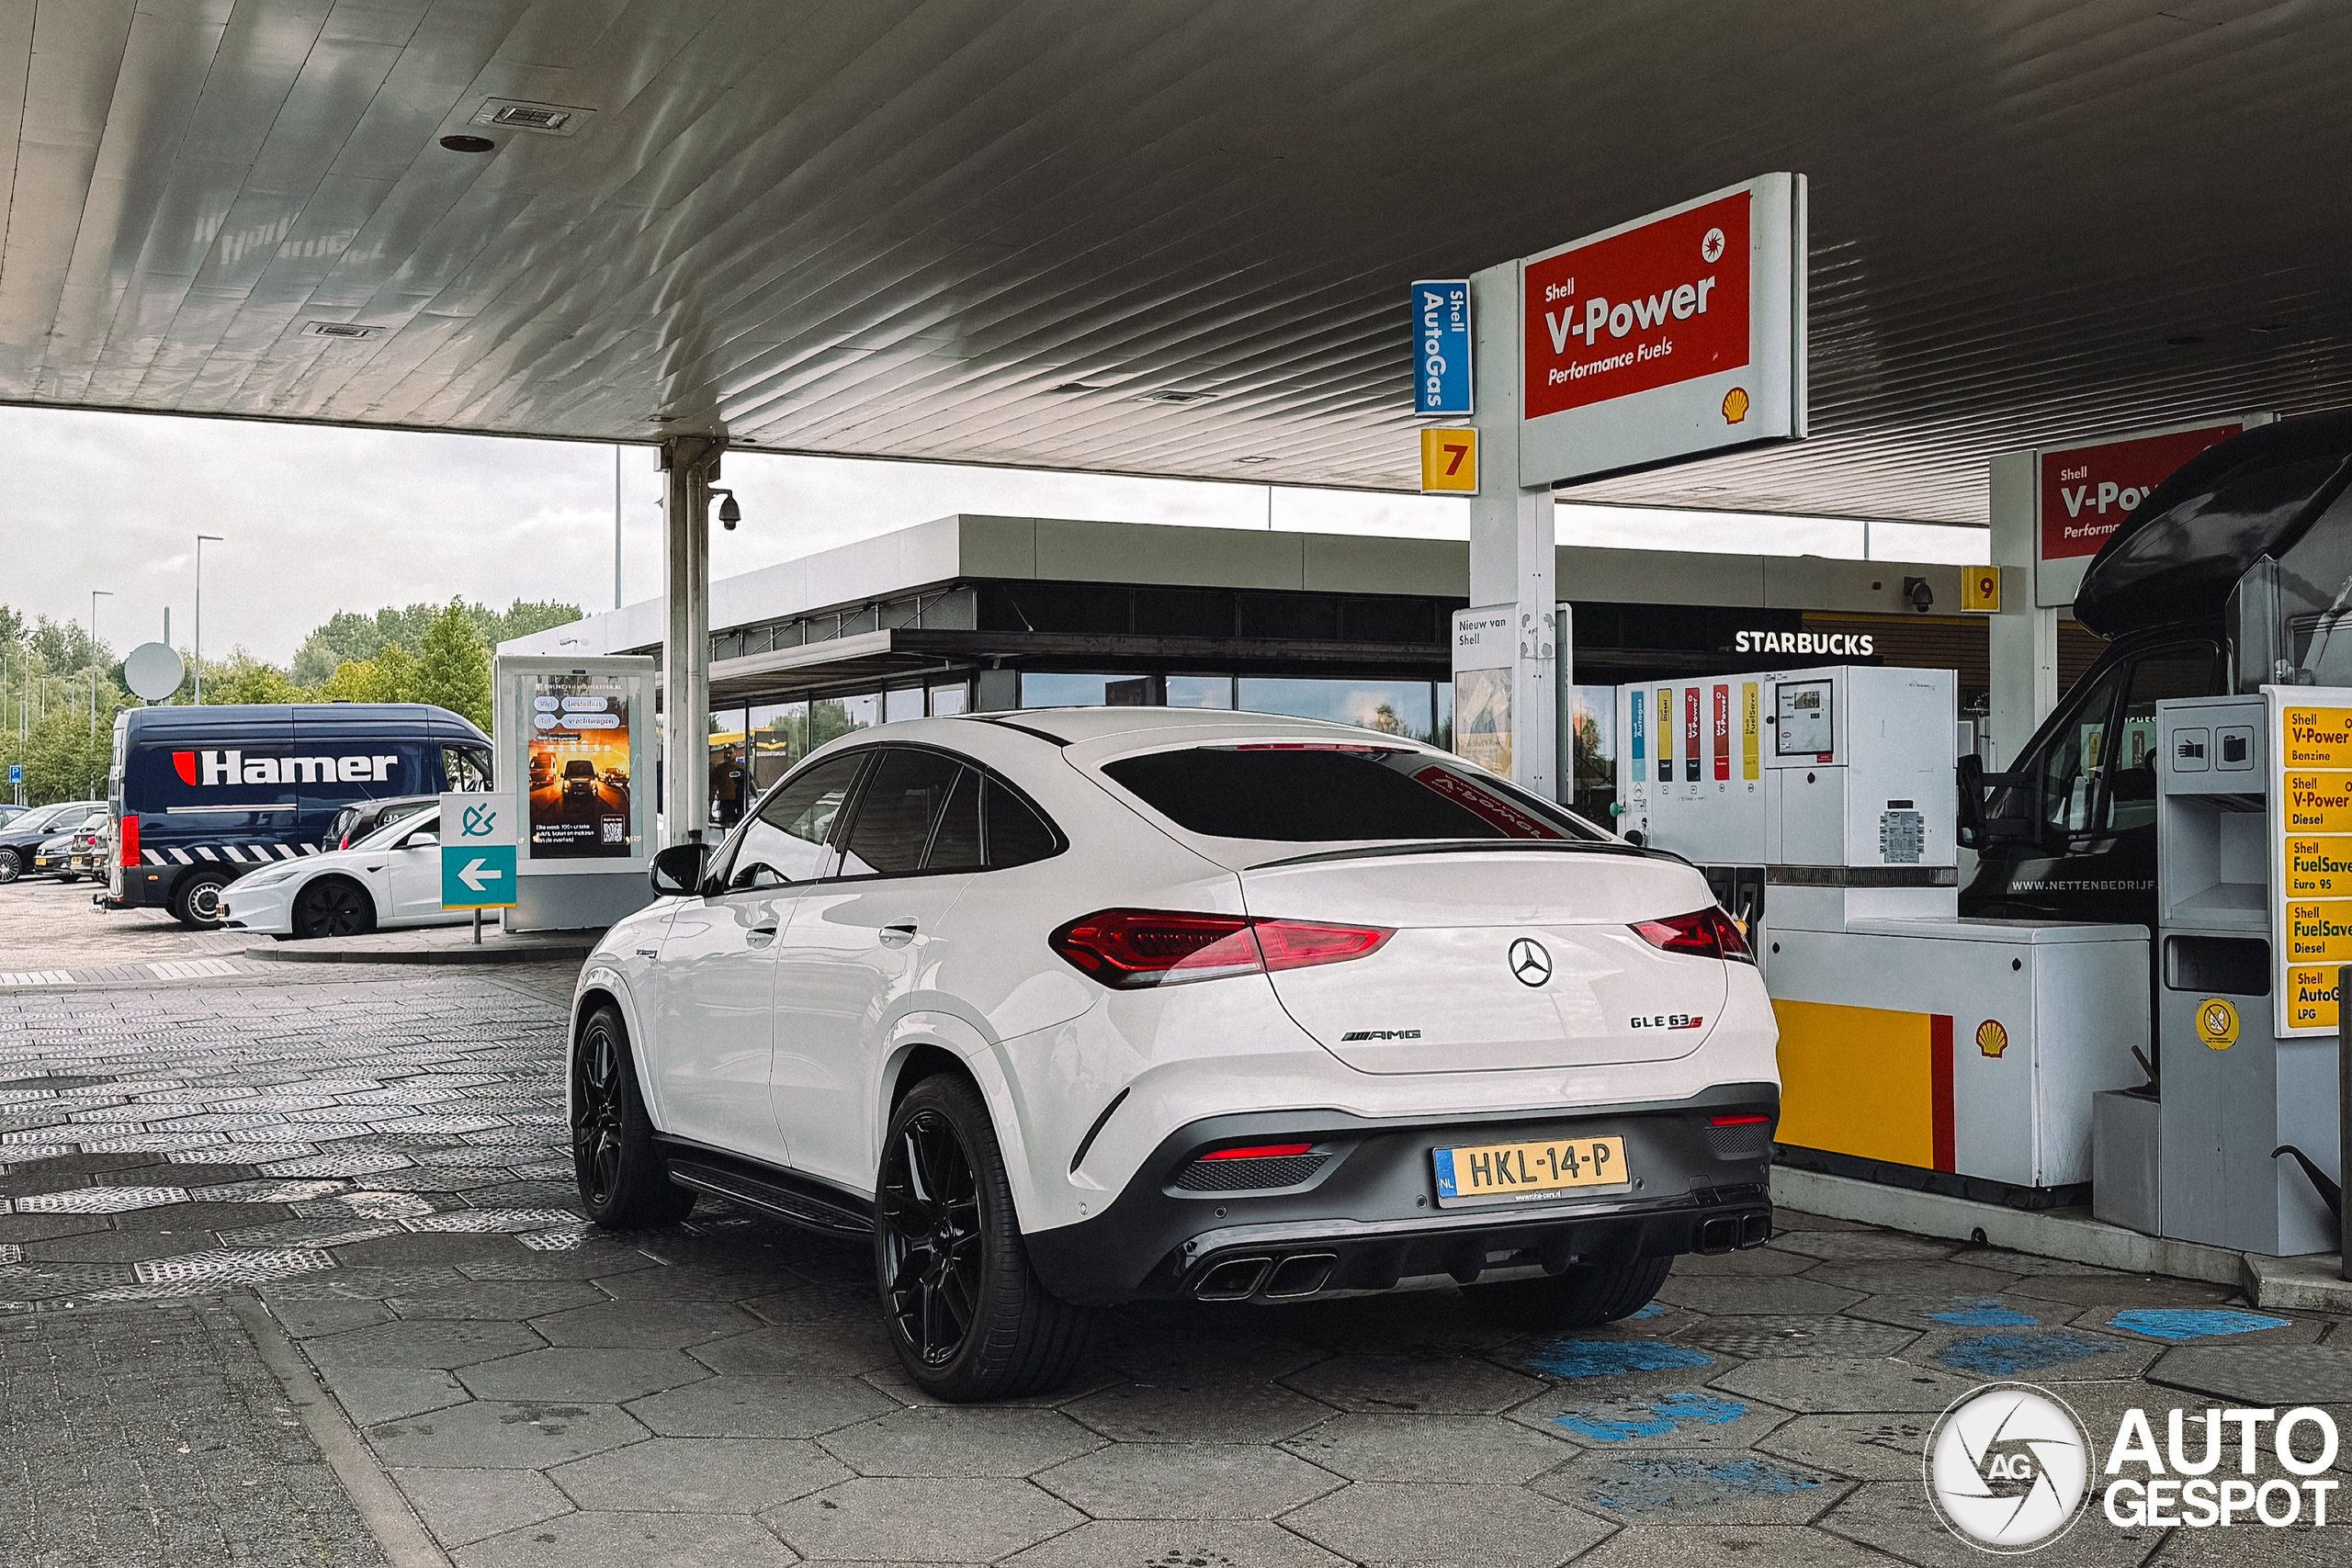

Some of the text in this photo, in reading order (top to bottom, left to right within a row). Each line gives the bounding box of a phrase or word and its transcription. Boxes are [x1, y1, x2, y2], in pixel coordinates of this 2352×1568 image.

[1545, 277, 1575, 303] Shell
[1450, 290, 1465, 333] Shell
[1545, 275, 1716, 355] V-Power
[1423, 290, 1447, 407] AutoGas
[1548, 336, 1673, 386] Performance Fuels
[1443, 445, 1468, 476] 7
[2061, 466, 2087, 481] Shell
[1980, 578, 1994, 599] 9
[1459, 619, 1506, 631] Nieuw van
[1459, 633, 1480, 646] Shell
[1736, 630, 1874, 657] STARBUCKS
[568, 717, 614, 726] vrachtwagen
[2292, 714, 2316, 725] Shell
[2292, 728, 2349, 743] V-Power
[2292, 750, 2330, 761] Benzine
[12, 767, 19, 776] P
[201, 750, 399, 786] Hamer
[2292, 778, 2317, 789] Shell
[2293, 792, 2349, 808] V-Power
[2292, 813, 2324, 825] Diesel
[2294, 842, 2319, 854] Shell
[2294, 855, 2352, 873] FuelSave
[2294, 879, 2332, 890] Euro 95
[2294, 907, 2319, 919] Shell
[2294, 920, 2352, 937] FuelSave
[2294, 942, 2325, 954] Diesel
[2299, 973, 2323, 984] Shell
[2299, 1010, 2316, 1020] LPG
[1631, 1015, 1665, 1029] GLE
[1368, 1030, 1421, 1040] AMG
[1470, 1143, 1611, 1187] HKL-14-P
[1440, 1179, 1454, 1190] NL
